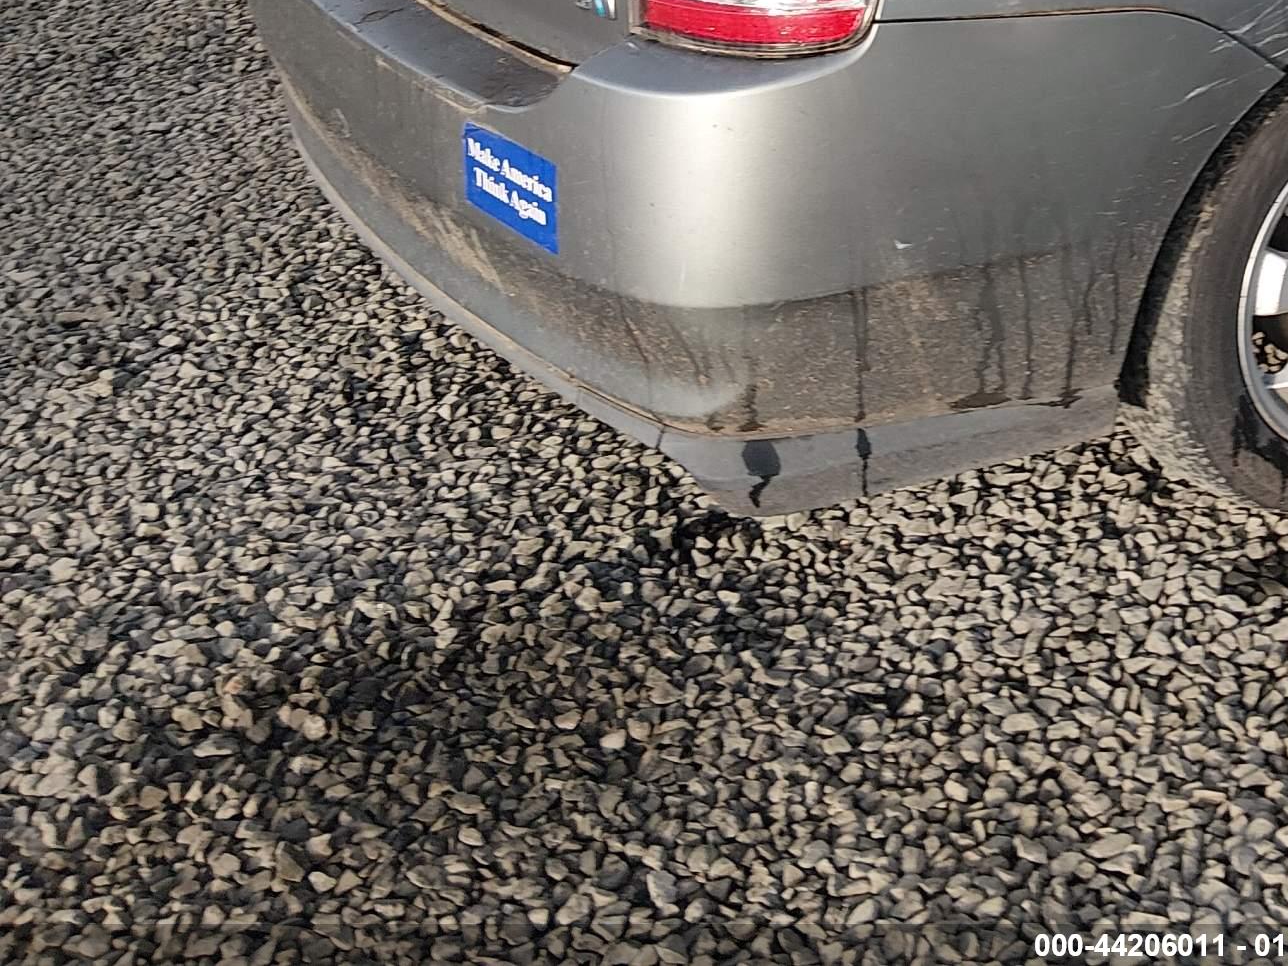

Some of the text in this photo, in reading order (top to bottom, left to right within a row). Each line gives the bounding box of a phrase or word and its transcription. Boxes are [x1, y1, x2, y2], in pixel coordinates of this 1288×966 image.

[467, 137, 553, 203] Make America
[473, 166, 547, 226] Think Again
